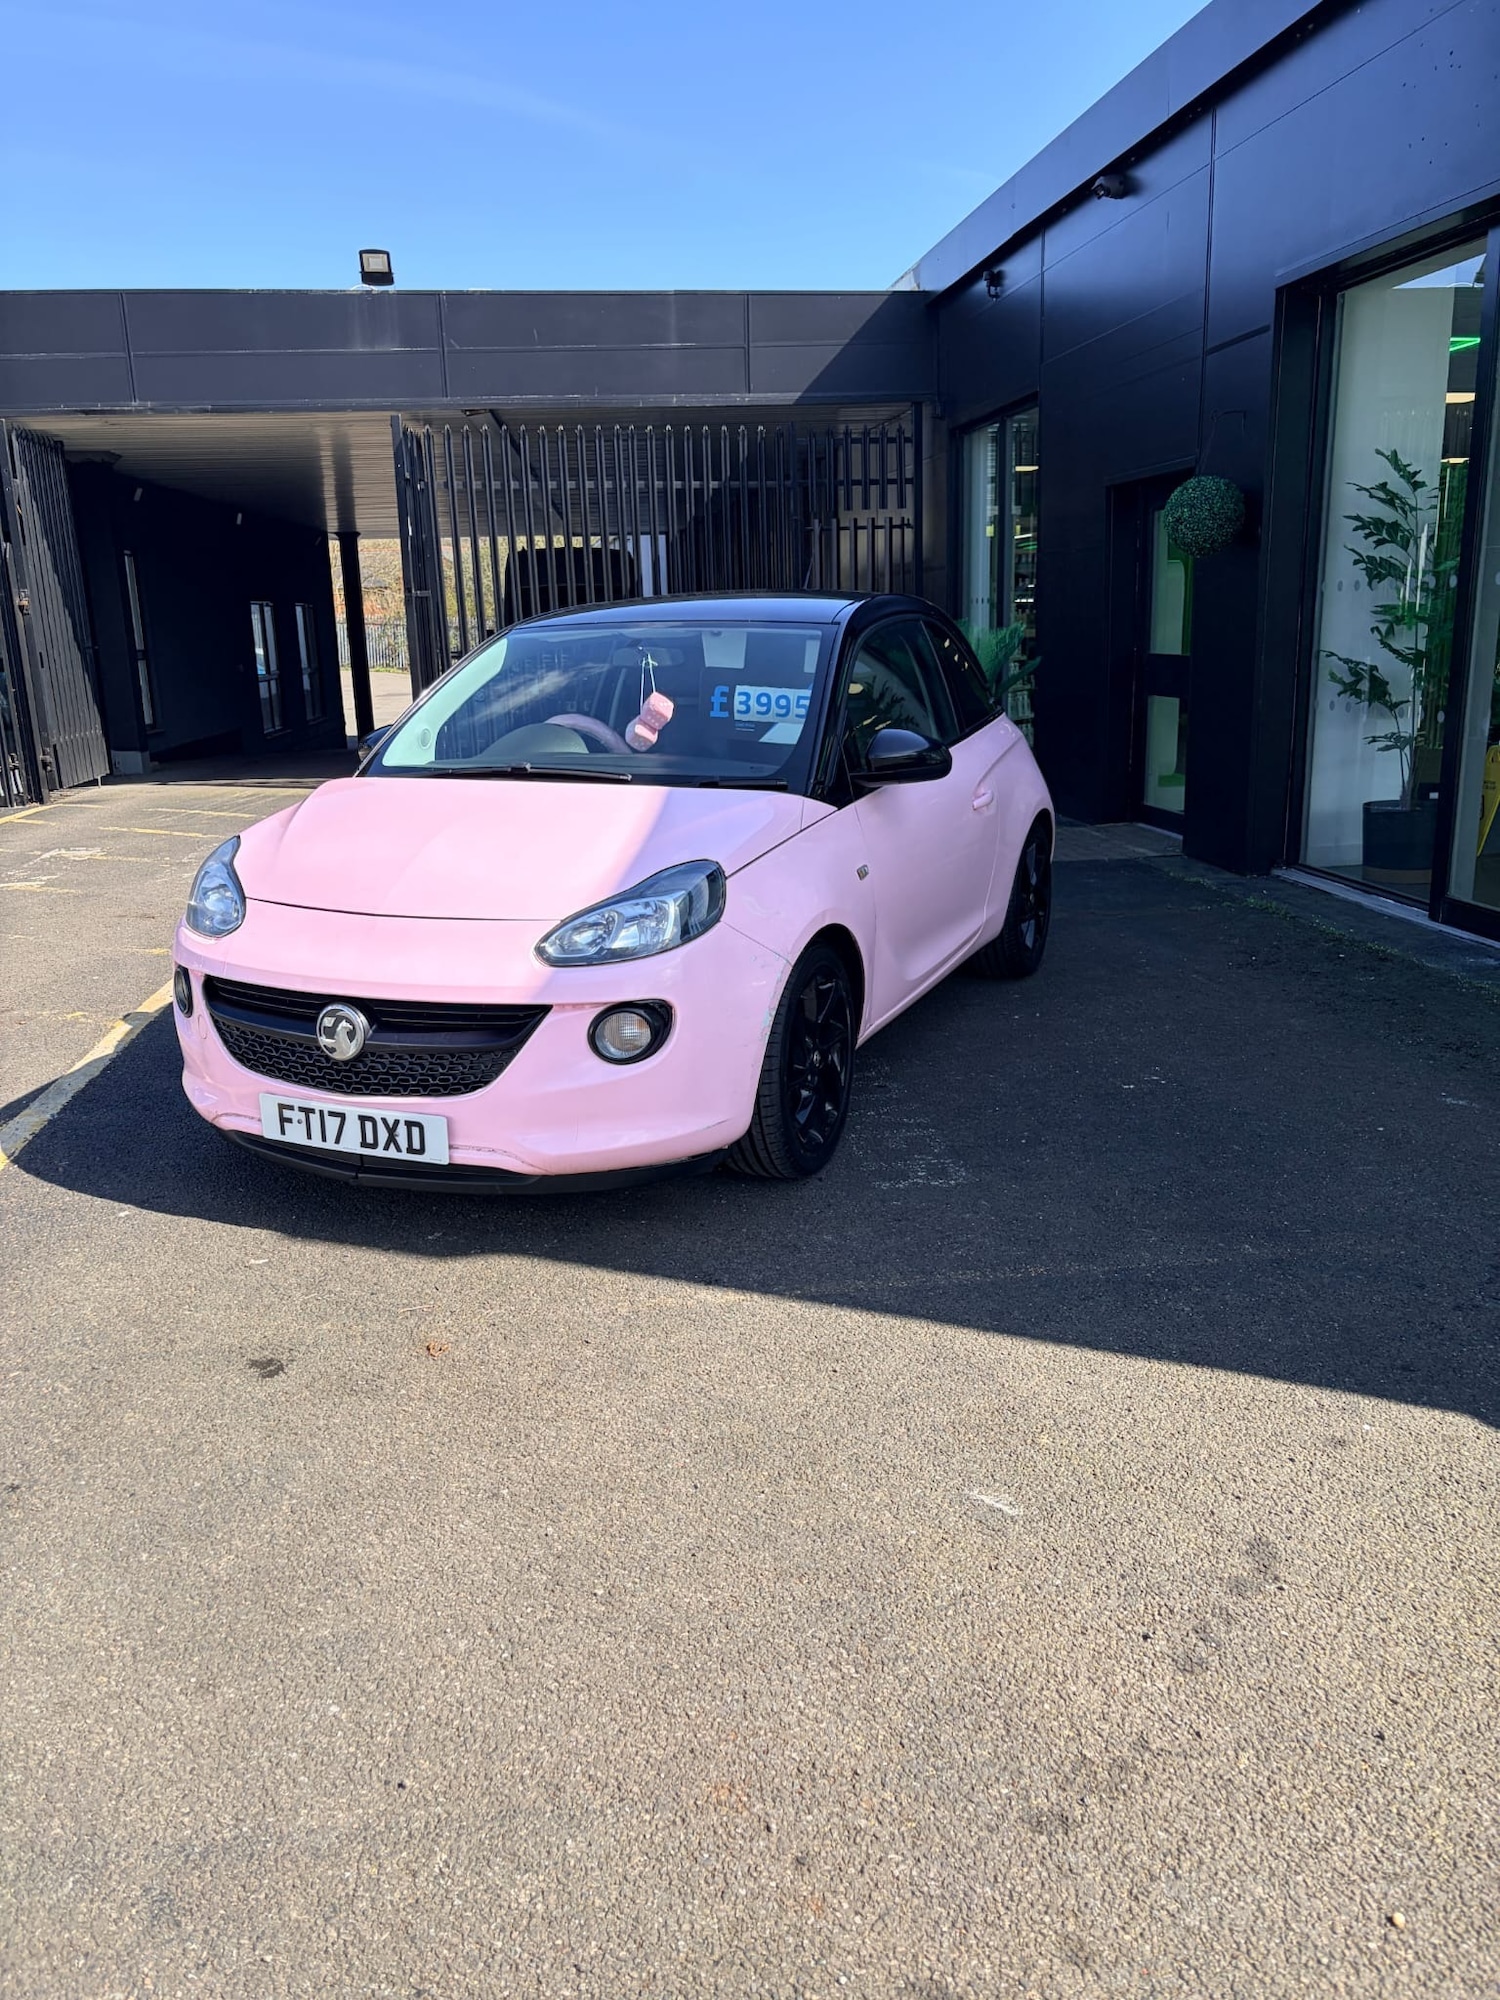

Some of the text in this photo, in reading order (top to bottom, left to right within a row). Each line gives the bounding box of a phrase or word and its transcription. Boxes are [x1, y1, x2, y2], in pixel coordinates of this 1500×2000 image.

[709, 685, 811, 719] £3995
[277, 1102, 426, 1156] FT17 DXD
